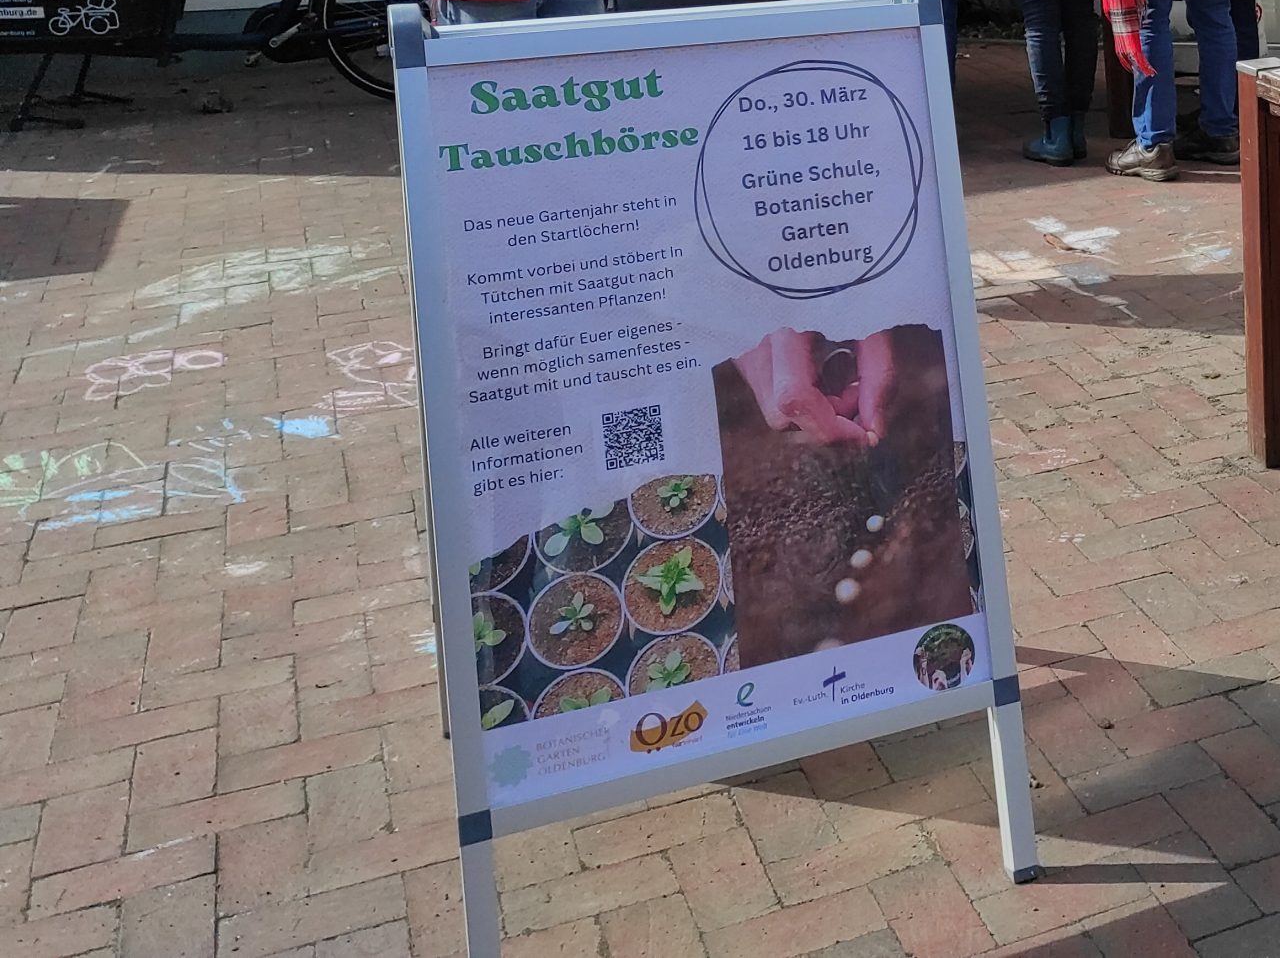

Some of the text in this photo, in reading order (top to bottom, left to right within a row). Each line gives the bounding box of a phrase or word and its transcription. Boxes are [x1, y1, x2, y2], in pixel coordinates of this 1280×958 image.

[470, 68, 664, 114] Saatgut
[739, 87, 867, 113] Do., 30. März
[439, 127, 699, 172] Tauschbörse
[743, 123, 870, 151] 16 bis 18 Uhr
[742, 160, 880, 190] Grüne Schule,
[464, 195, 677, 232] Das neue Gartenjahr steht in
[754, 190, 873, 217] Botanischer
[507, 219, 640, 247] den Startlöchern!
[781, 221, 849, 242] Garten
[467, 246, 683, 286] Kommt vorbei und stöbert in
[768, 245, 874, 272] Oldenburg
[481, 267, 674, 305] Tütchen mit Saatgut nach
[489, 288, 666, 324] interessanten Pflanzen!
[482, 341, 530, 360] Bringt
[534, 335, 575, 352] dafür
[580, 329, 613, 345] Euer
[617, 320, 673, 340] eigenes
[477, 365, 519, 381] wenn
[524, 353, 584, 374] möglich
[588, 338, 681, 364] samenfestes
[469, 355, 702, 404] Saatgut mit und tauscht es ein.
[470, 425, 571, 452] Alle weiteren
[471, 444, 583, 472] Informationen
[473, 468, 564, 497] gibt es hier:
[840, 681, 866, 694] Kirche
[841, 685, 895, 705] in Oldenburg
[726, 715, 765, 730] entwickeln
[536, 746, 581, 764] GARTEN
[538, 753, 606, 776] OLDENBURG
